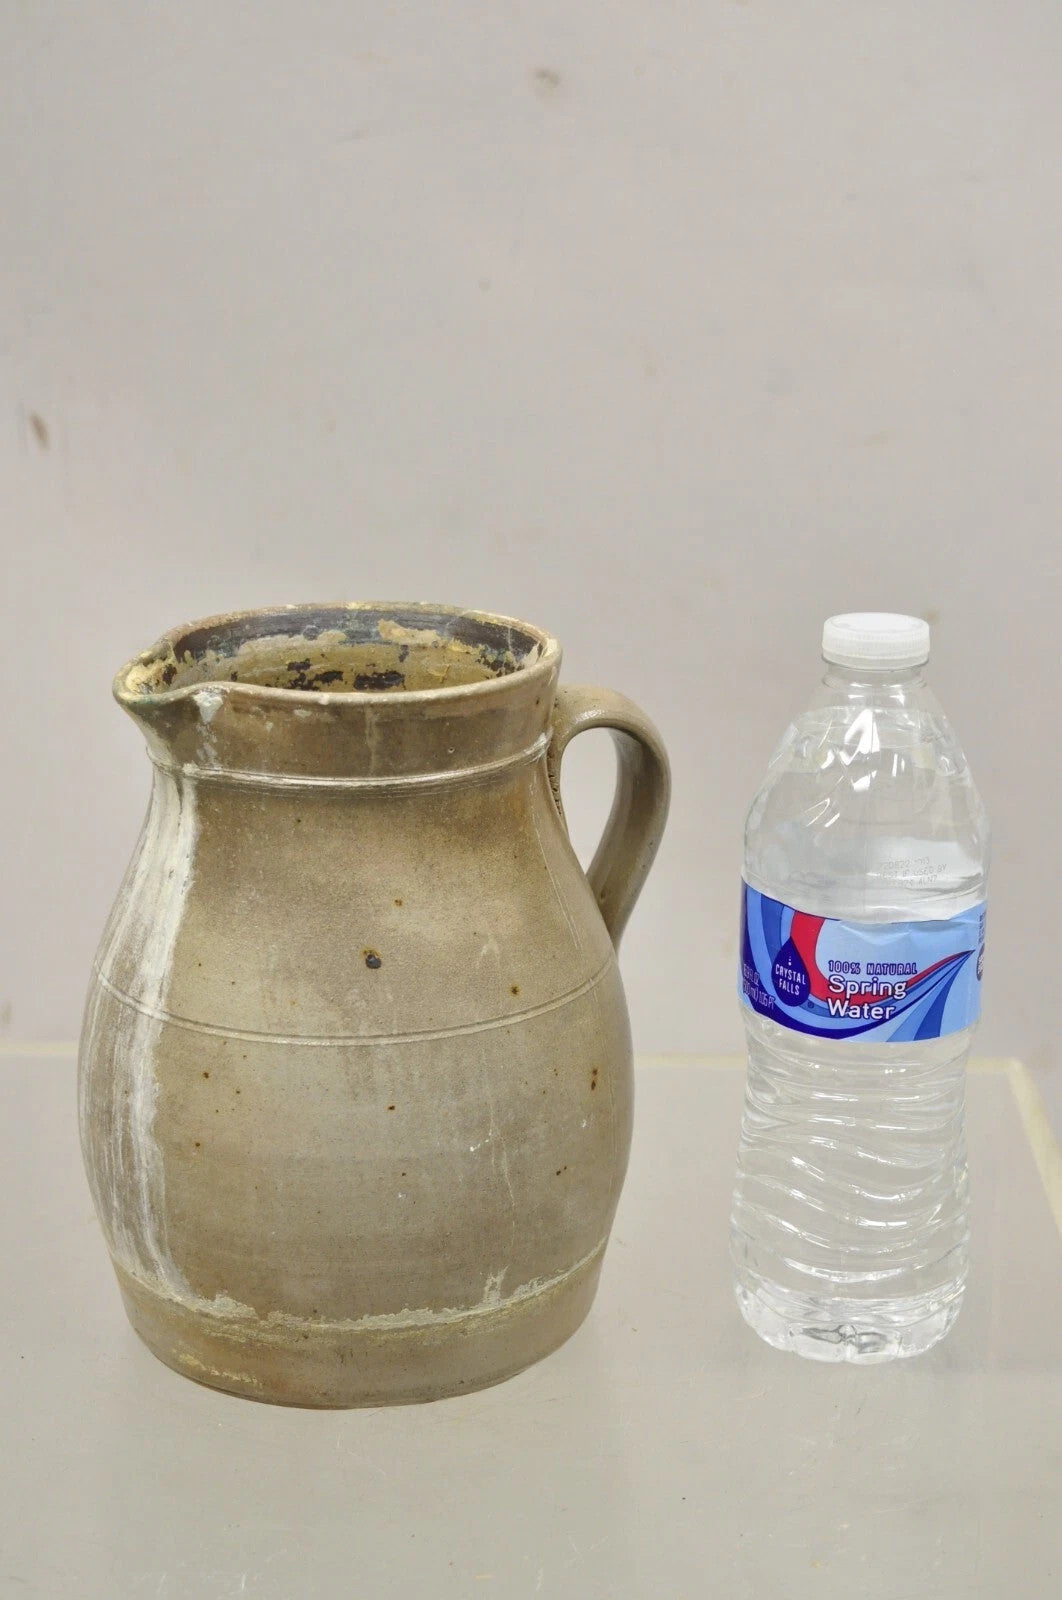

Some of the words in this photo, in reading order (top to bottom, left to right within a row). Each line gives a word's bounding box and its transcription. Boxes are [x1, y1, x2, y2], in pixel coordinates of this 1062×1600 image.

[775, 963, 806, 985] CRYSTAL
[828, 959, 861, 975] 100%
[866, 961, 918, 975] NATURAL
[778, 978, 800, 996] FALLS
[828, 975, 907, 999] Spring
[828, 997, 895, 1020] Water
